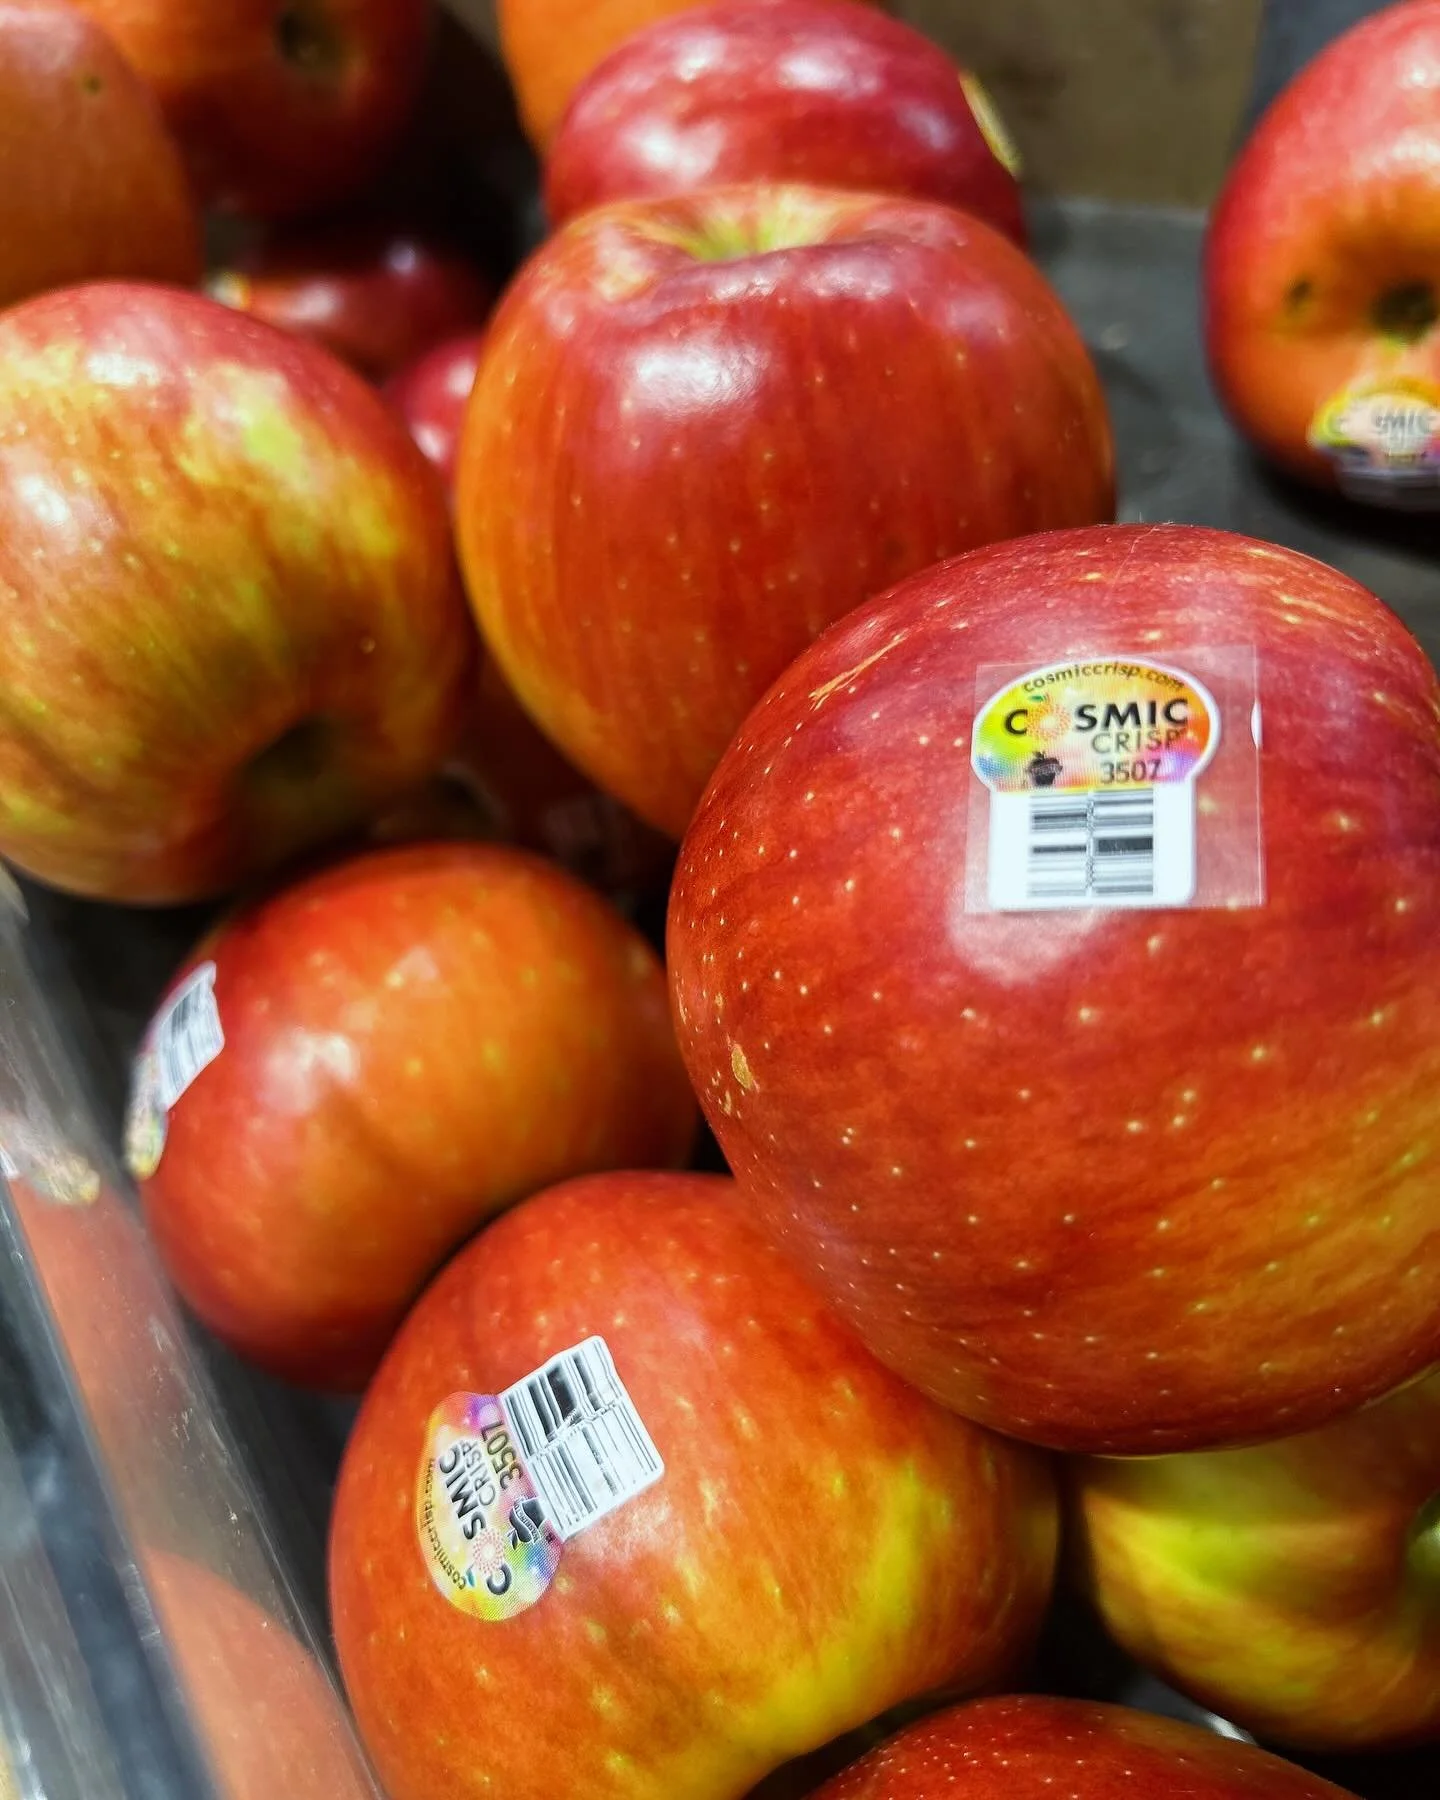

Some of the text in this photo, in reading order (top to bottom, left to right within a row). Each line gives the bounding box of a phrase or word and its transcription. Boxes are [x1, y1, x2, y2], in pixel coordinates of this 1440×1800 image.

[1023, 661, 1185, 691] cosmiccrisp.com
[1092, 728, 1181, 754] CRISP
[1099, 758, 1162, 784] 3507
[481, 1419, 524, 1490] 3507
[461, 1440, 496, 1506] CRISP
